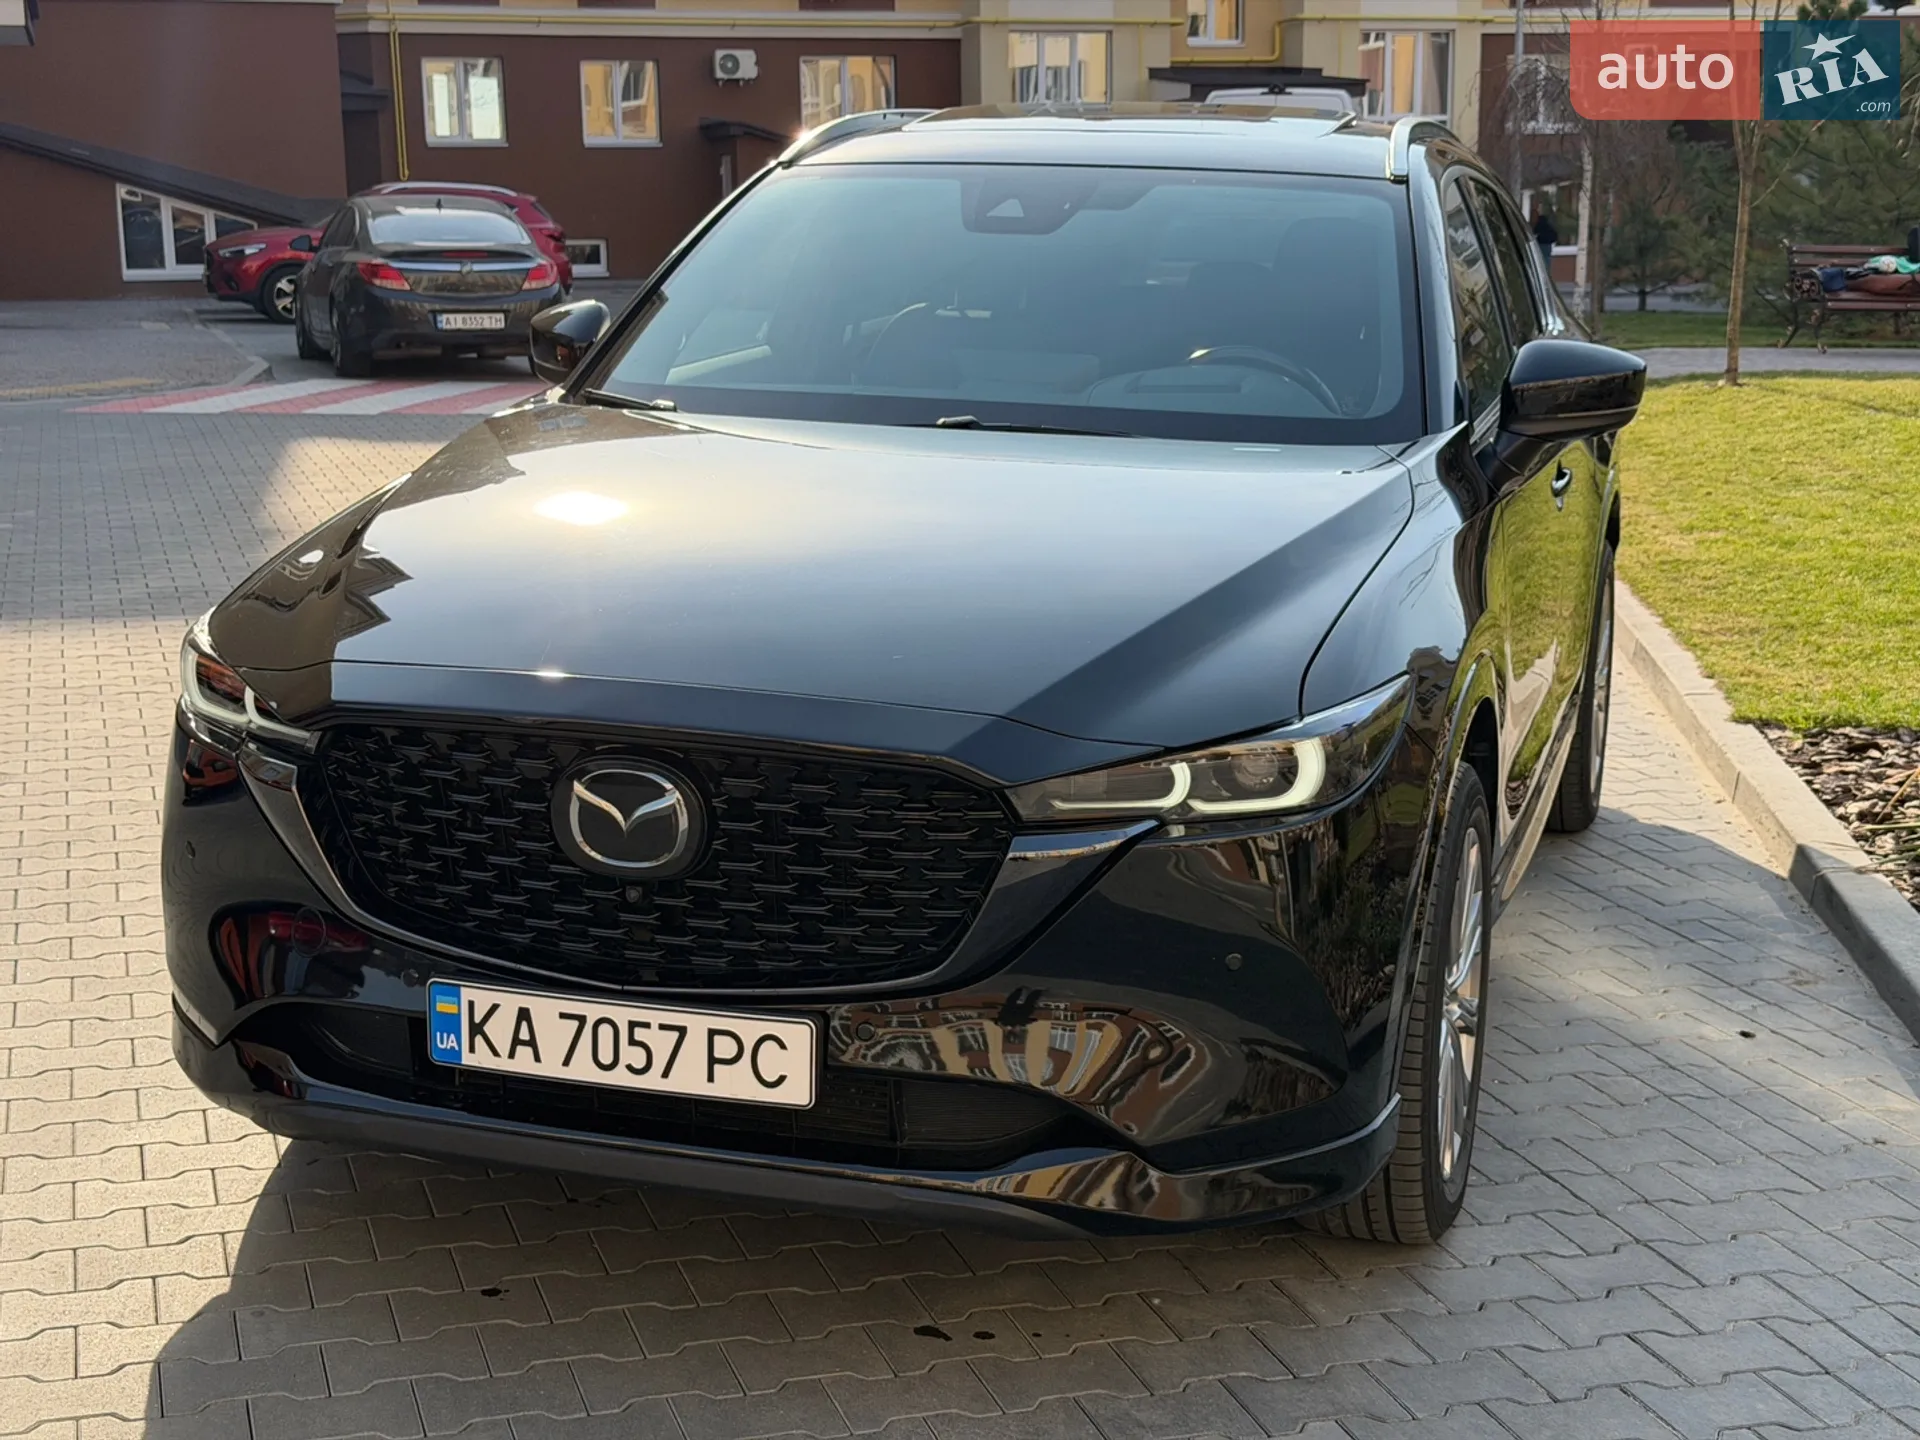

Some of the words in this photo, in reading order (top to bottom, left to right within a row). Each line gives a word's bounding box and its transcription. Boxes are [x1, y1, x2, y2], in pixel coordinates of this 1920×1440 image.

[436, 1032, 458, 1051] UA
[467, 999, 542, 1064] KA
[558, 1011, 688, 1077] 7057
[706, 1027, 788, 1089] PC
